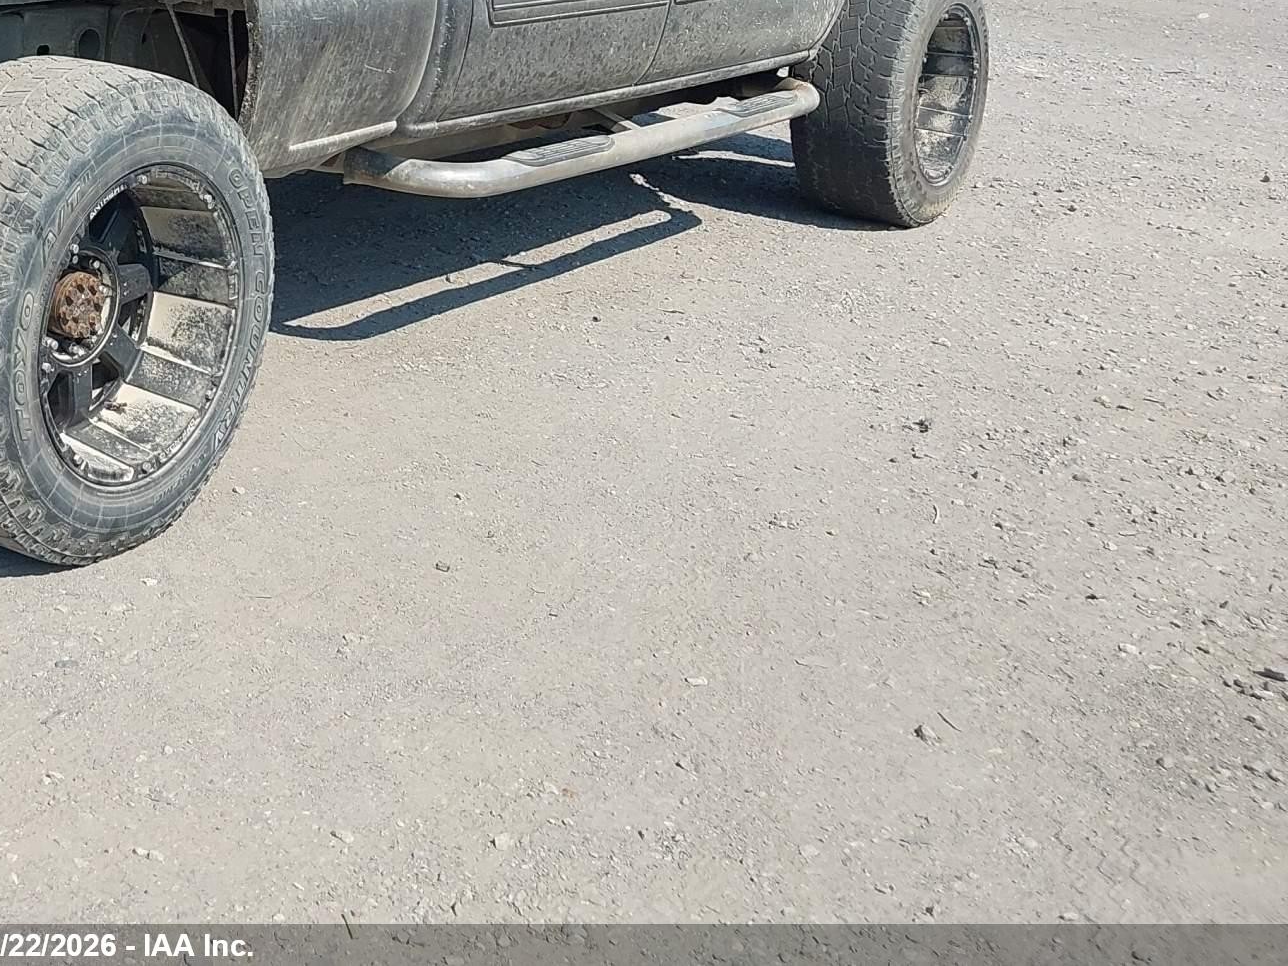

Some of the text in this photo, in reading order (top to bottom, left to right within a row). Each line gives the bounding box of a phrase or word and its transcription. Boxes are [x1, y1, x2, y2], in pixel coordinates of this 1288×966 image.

[14, 291, 35, 442] TOYO
[214, 167, 267, 451] OPEN COUNTRY
